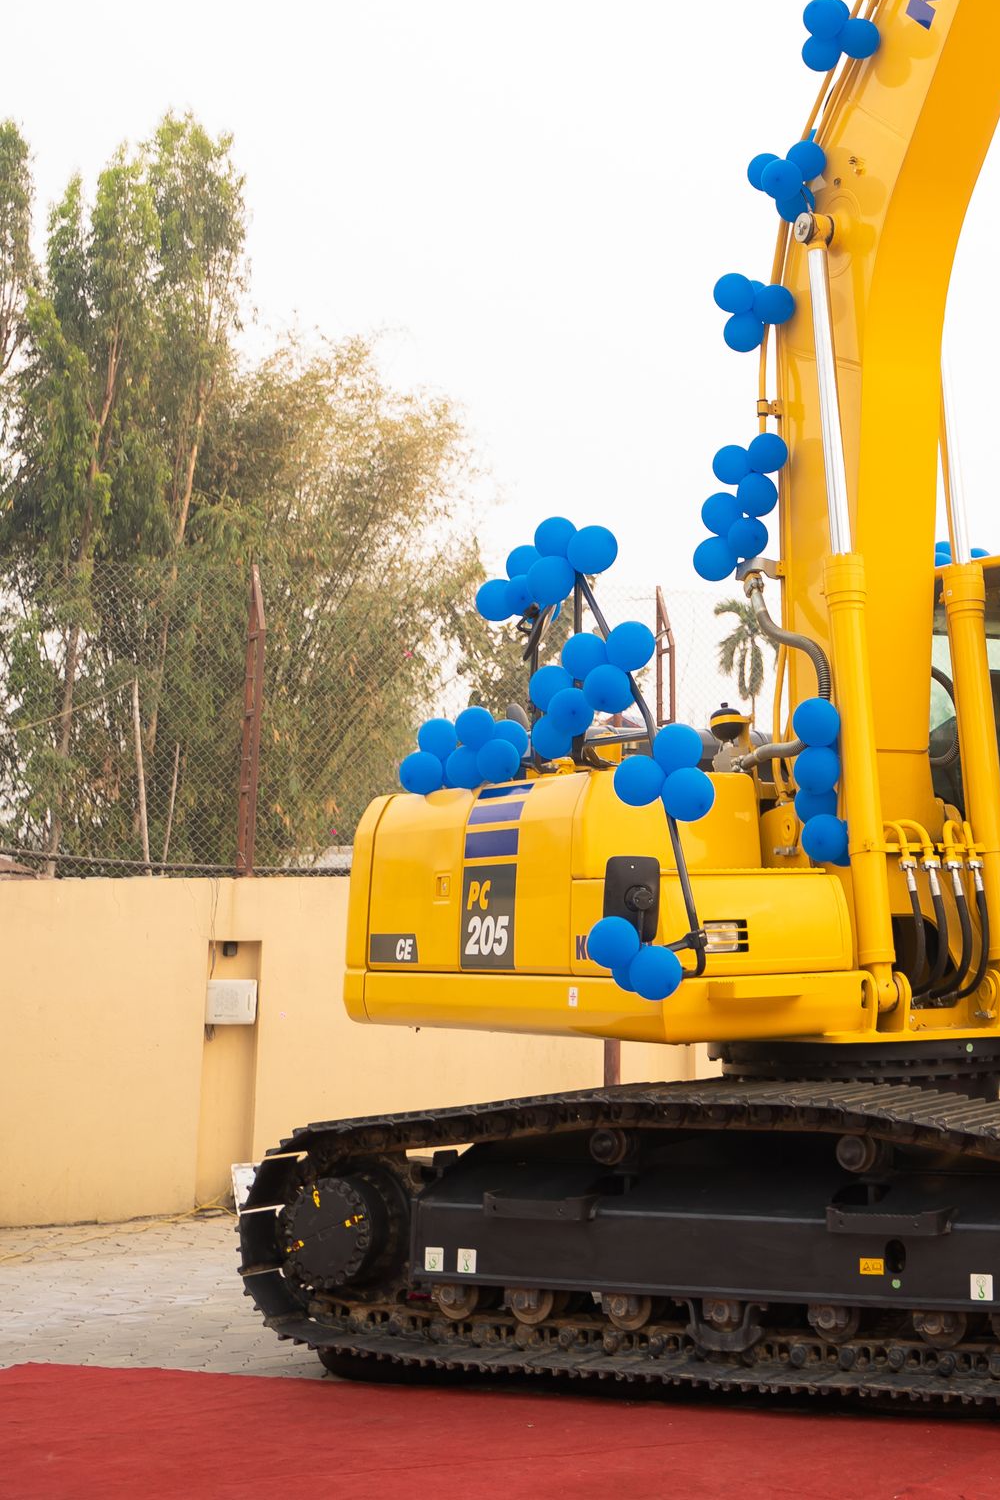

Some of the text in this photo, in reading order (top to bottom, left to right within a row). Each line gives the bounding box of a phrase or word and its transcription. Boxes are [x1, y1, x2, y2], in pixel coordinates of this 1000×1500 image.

[467, 880, 491, 910] PC
[395, 938, 413, 960] CE
[465, 915, 509, 956] 205
